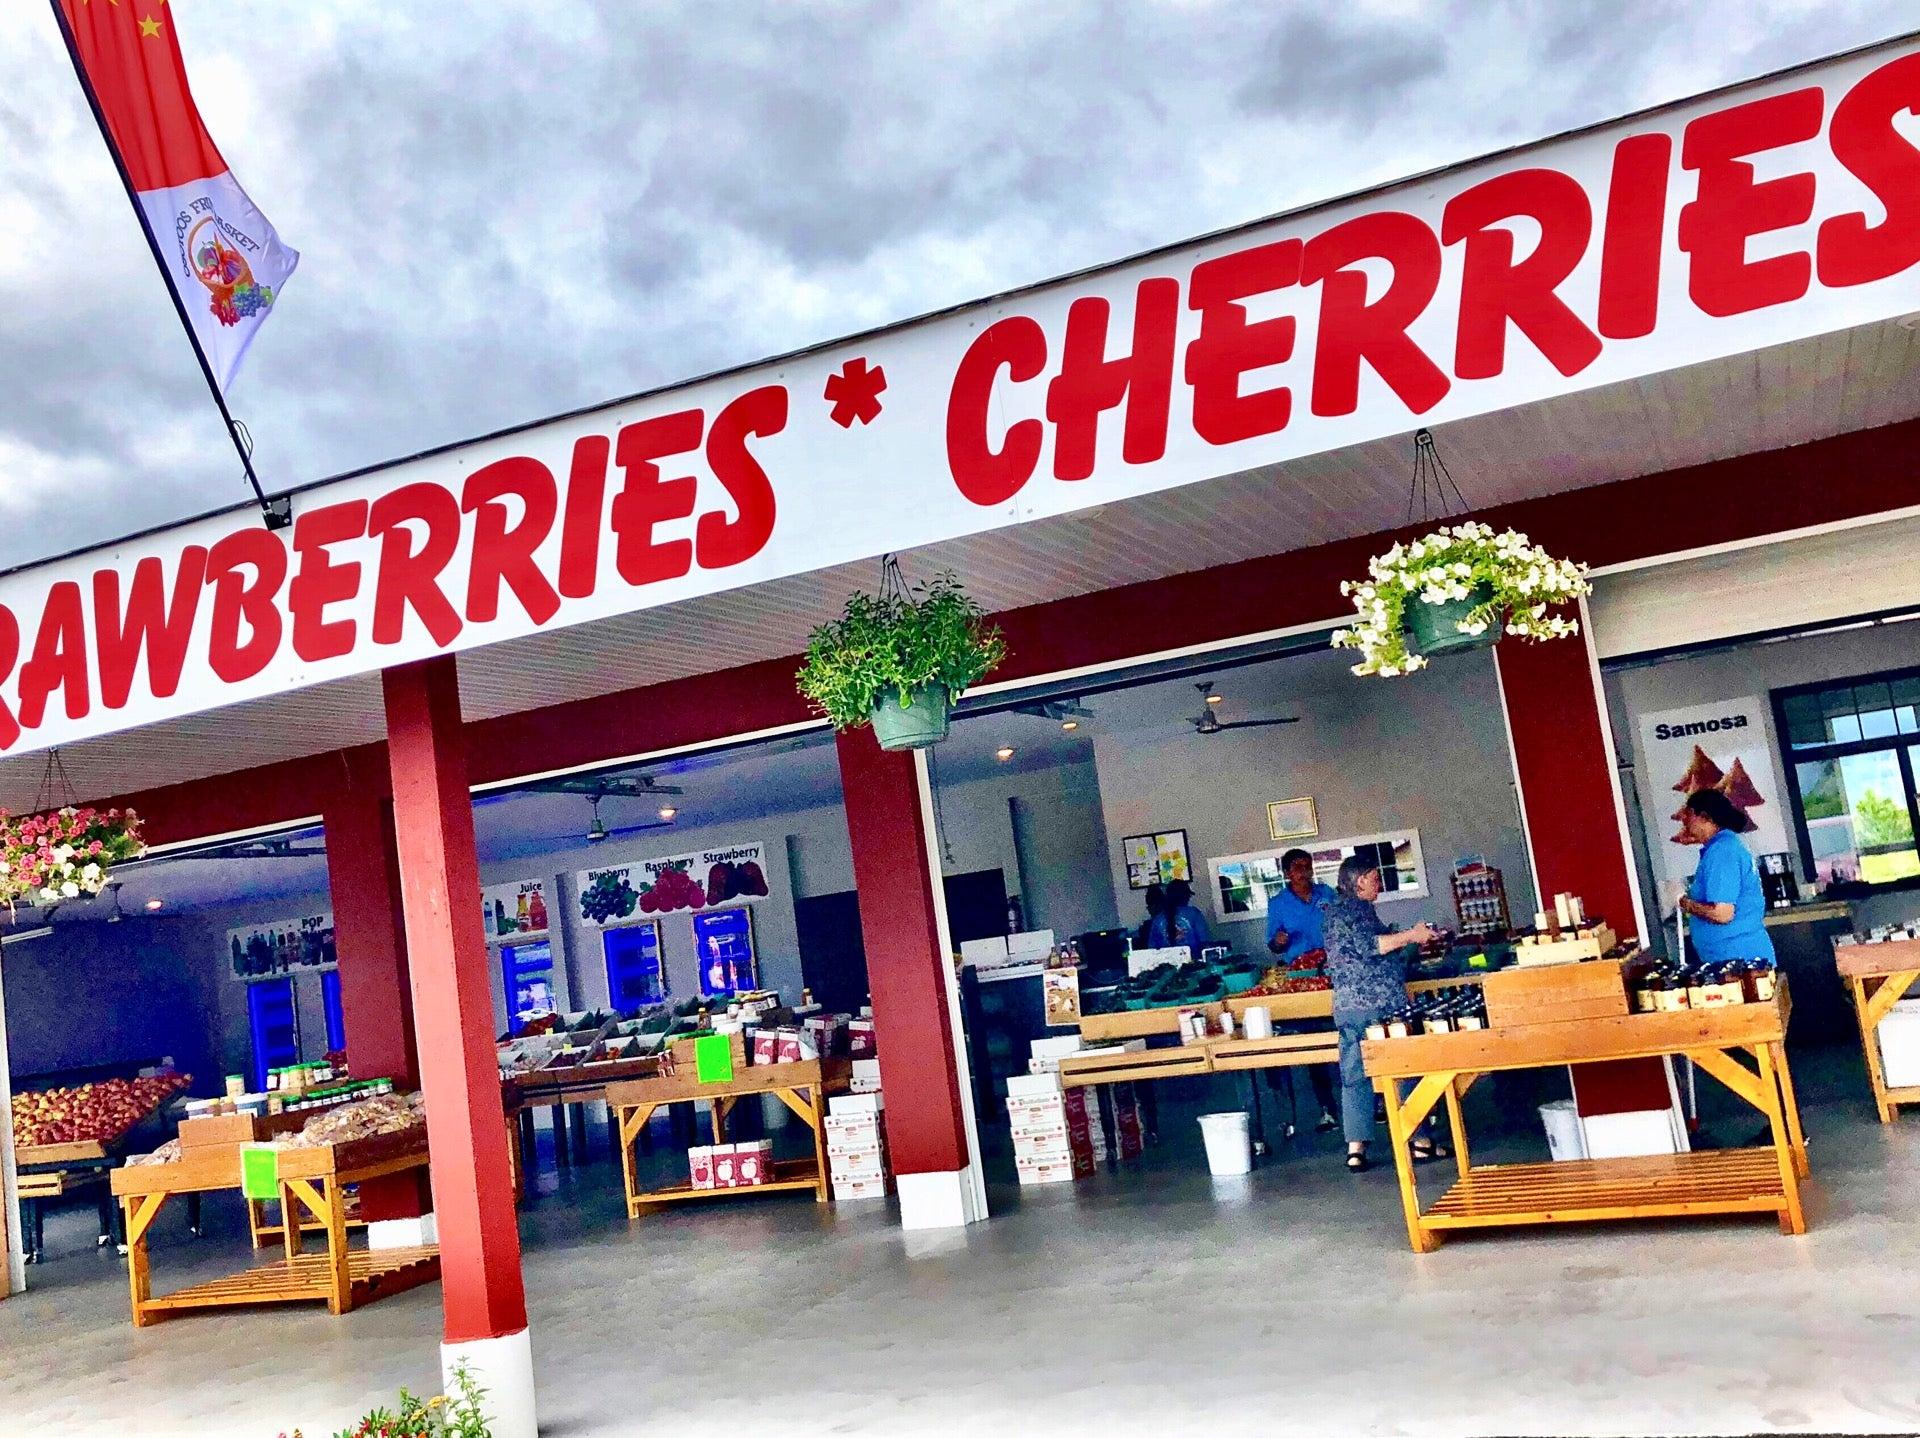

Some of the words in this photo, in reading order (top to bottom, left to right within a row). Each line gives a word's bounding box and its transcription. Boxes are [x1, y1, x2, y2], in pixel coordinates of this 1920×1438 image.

[215, 215, 261, 253] ASKET
[0, 386, 787, 750] AWBERRIES
[947, 52, 1920, 505] CHERRIES
[1655, 714, 1748, 740] Samosa
[644, 857, 694, 872] Raspberry
[703, 847, 760, 864] Strawberry
[520, 882, 543, 893] Juice
[302, 916, 324, 929] POP
